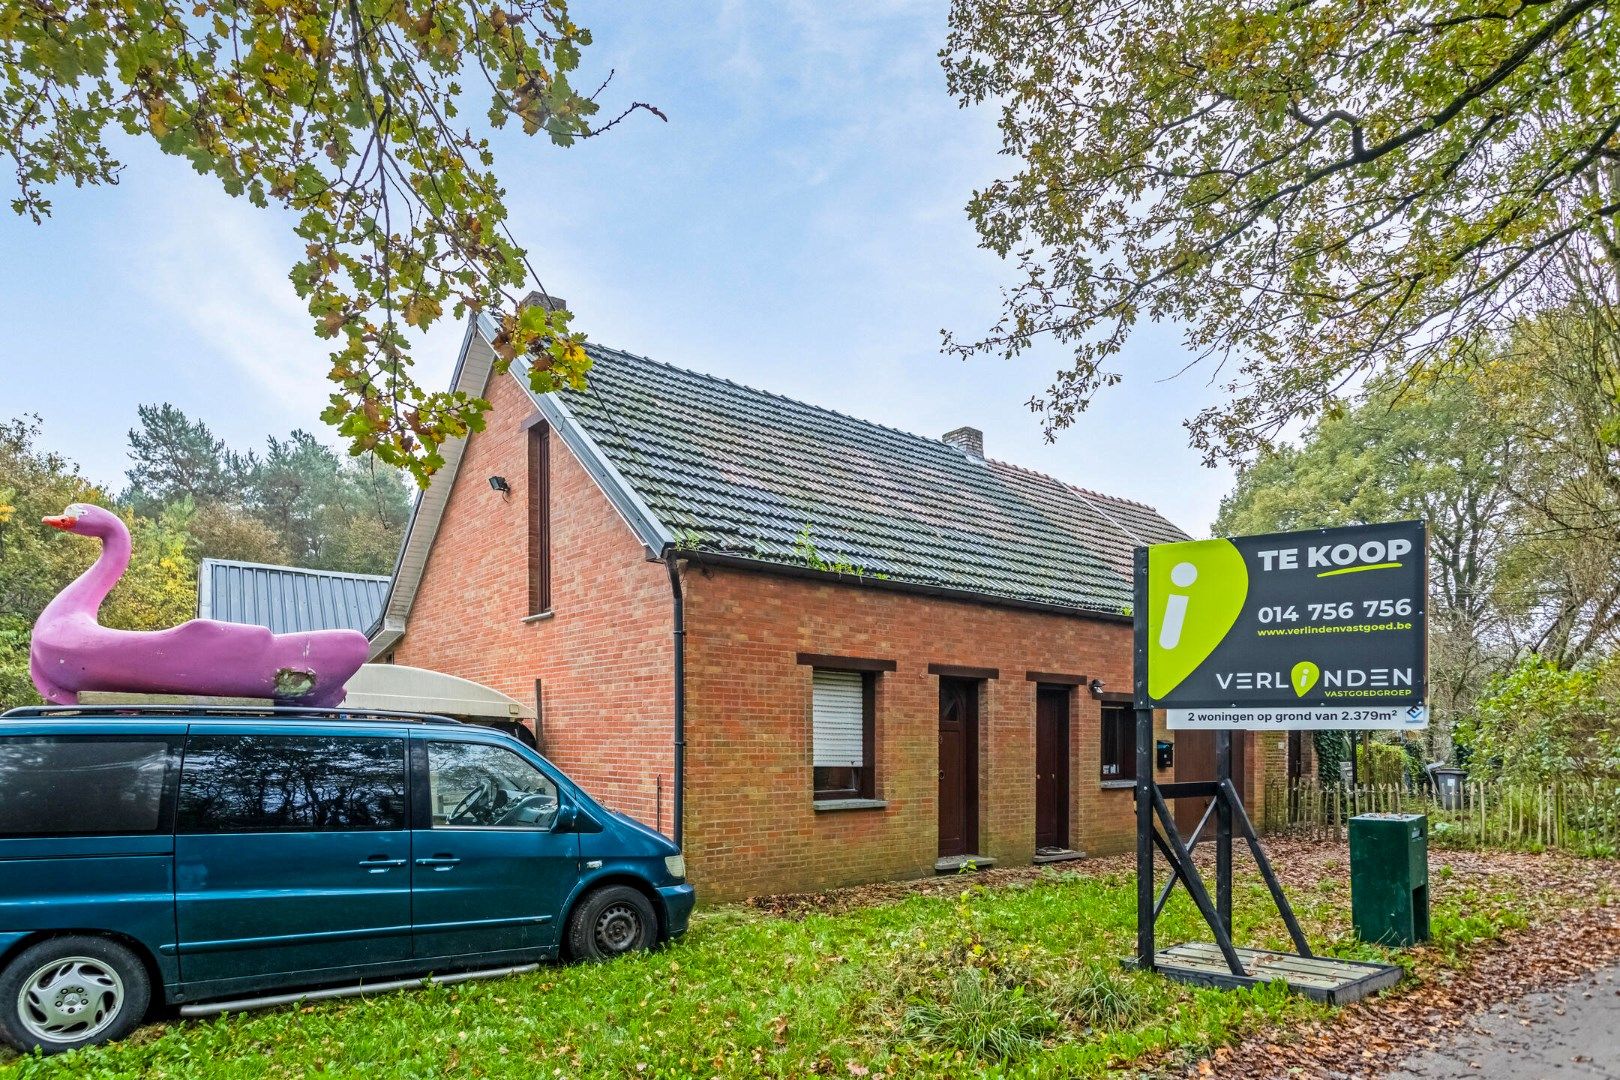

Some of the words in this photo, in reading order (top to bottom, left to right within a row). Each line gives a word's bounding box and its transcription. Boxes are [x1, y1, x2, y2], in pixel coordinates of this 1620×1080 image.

[1257, 548, 1299, 571] TE
[1307, 538, 1412, 568] KOOP
[1257, 605, 1299, 623] 014
[1307, 602, 1354, 621] 756
[1363, 598, 1412, 618] 756
[1257, 622, 1412, 636] www.verlindenvastgoed.be
[1324, 689, 1412, 698] VASTGOEDGROEP
[1187, 712, 1195, 722] 2
[1197, 711, 1254, 723] woningen
[1257, 713, 1272, 723] op
[1275, 711, 1311, 724] grond
[1314, 713, 1338, 721] van
[1341, 709, 1398, 722] 2.379m²
